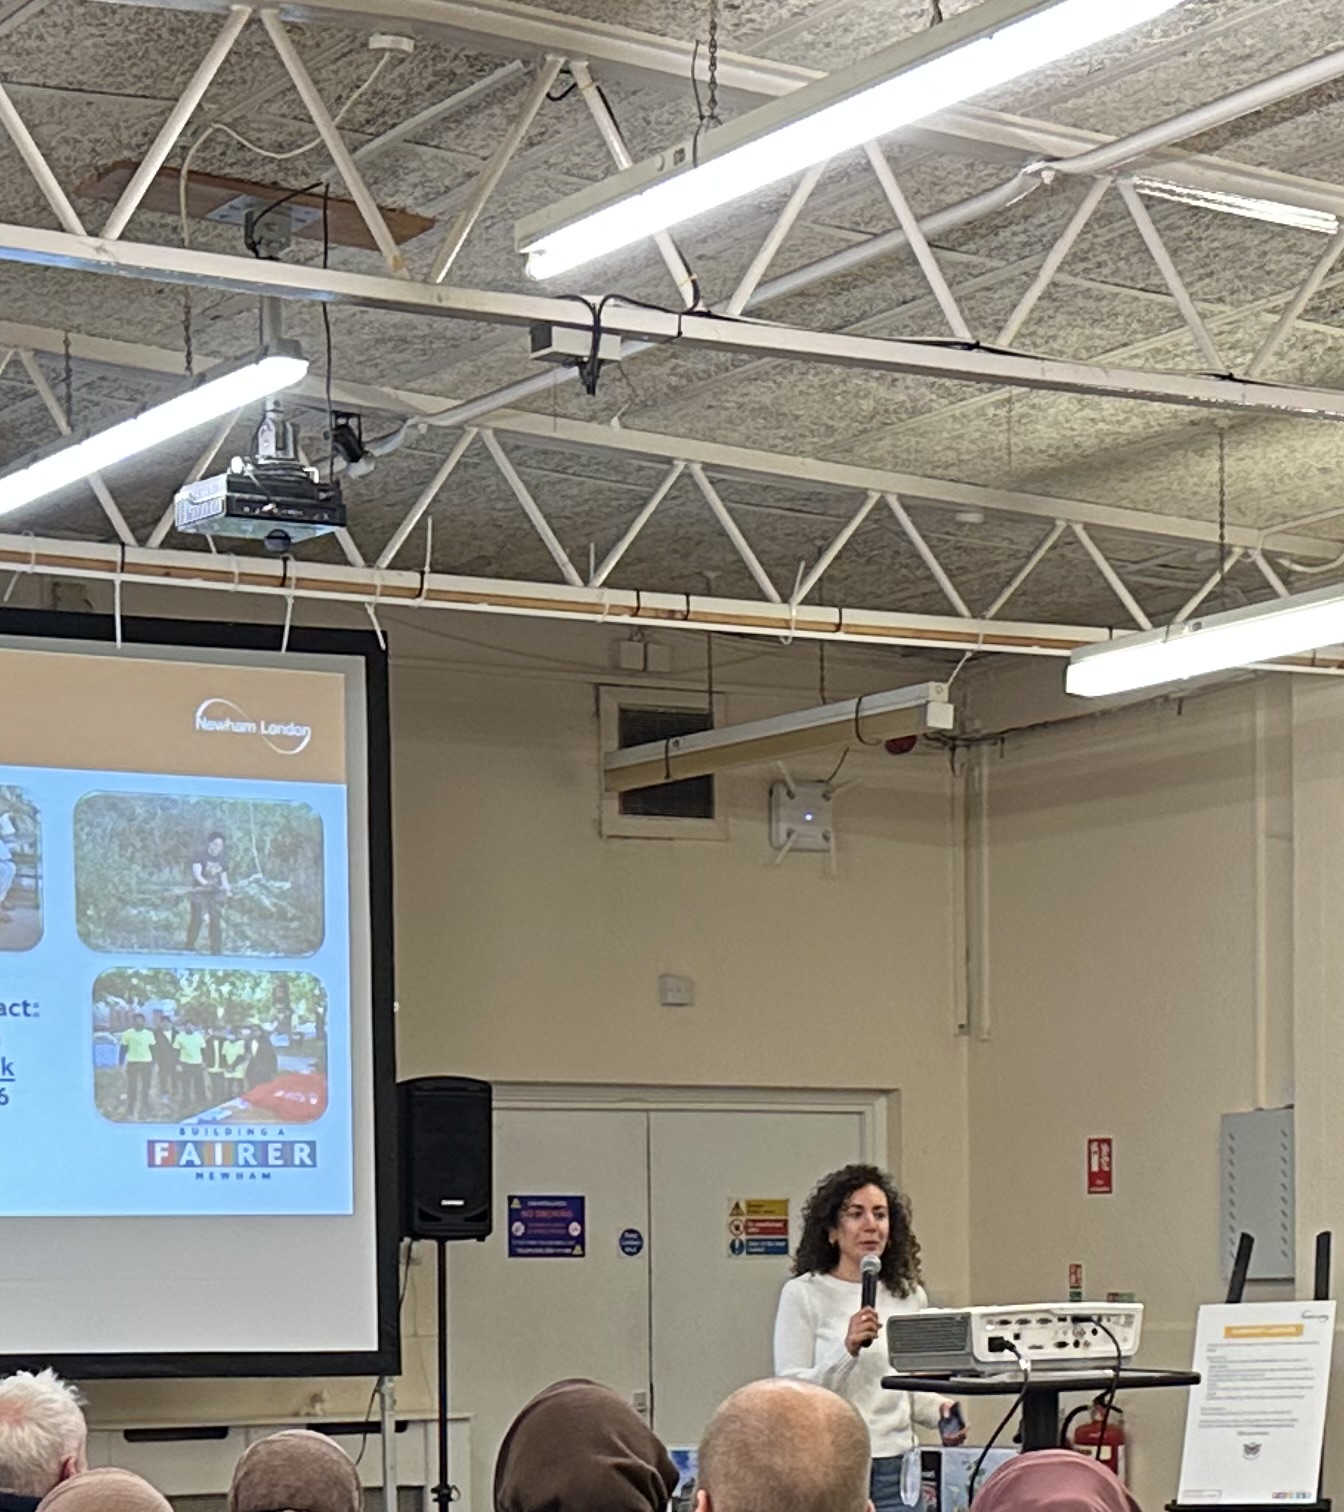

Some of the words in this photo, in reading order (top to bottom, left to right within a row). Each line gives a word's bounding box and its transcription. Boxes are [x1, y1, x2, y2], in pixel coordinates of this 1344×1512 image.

[196, 715, 257, 734] Newham
[260, 720, 312, 737] London
[179, 1127, 268, 1137] BUILDING
[277, 1127, 285, 1137] A
[154, 1142, 314, 1166] FAIRER
[195, 1171, 272, 1181] NEWHAM
